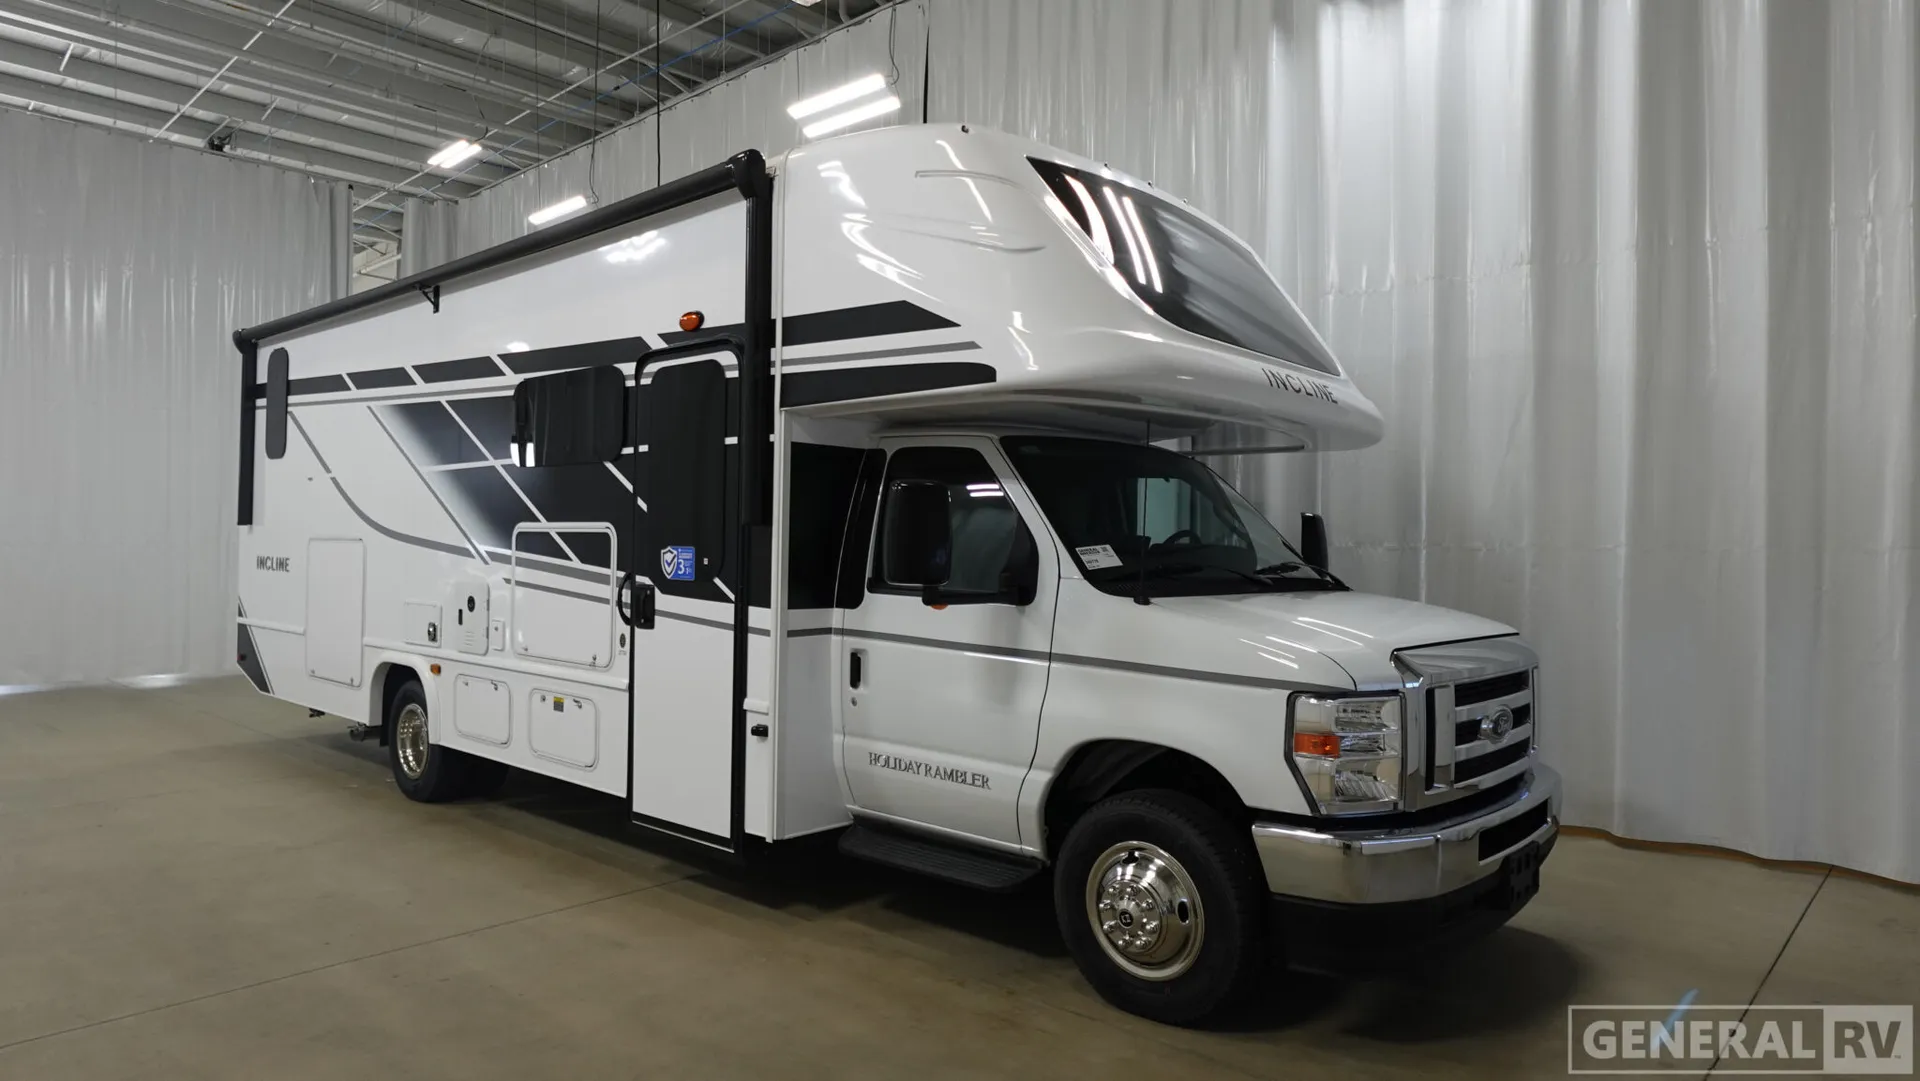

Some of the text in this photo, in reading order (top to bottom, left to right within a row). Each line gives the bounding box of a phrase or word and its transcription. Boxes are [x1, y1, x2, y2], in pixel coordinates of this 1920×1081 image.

[1262, 368, 1338, 404] INCLINE
[256, 555, 290, 573] INCLINE
[677, 559, 685, 575] 3
[868, 752, 992, 790] HOLIDAY RAMBLER
